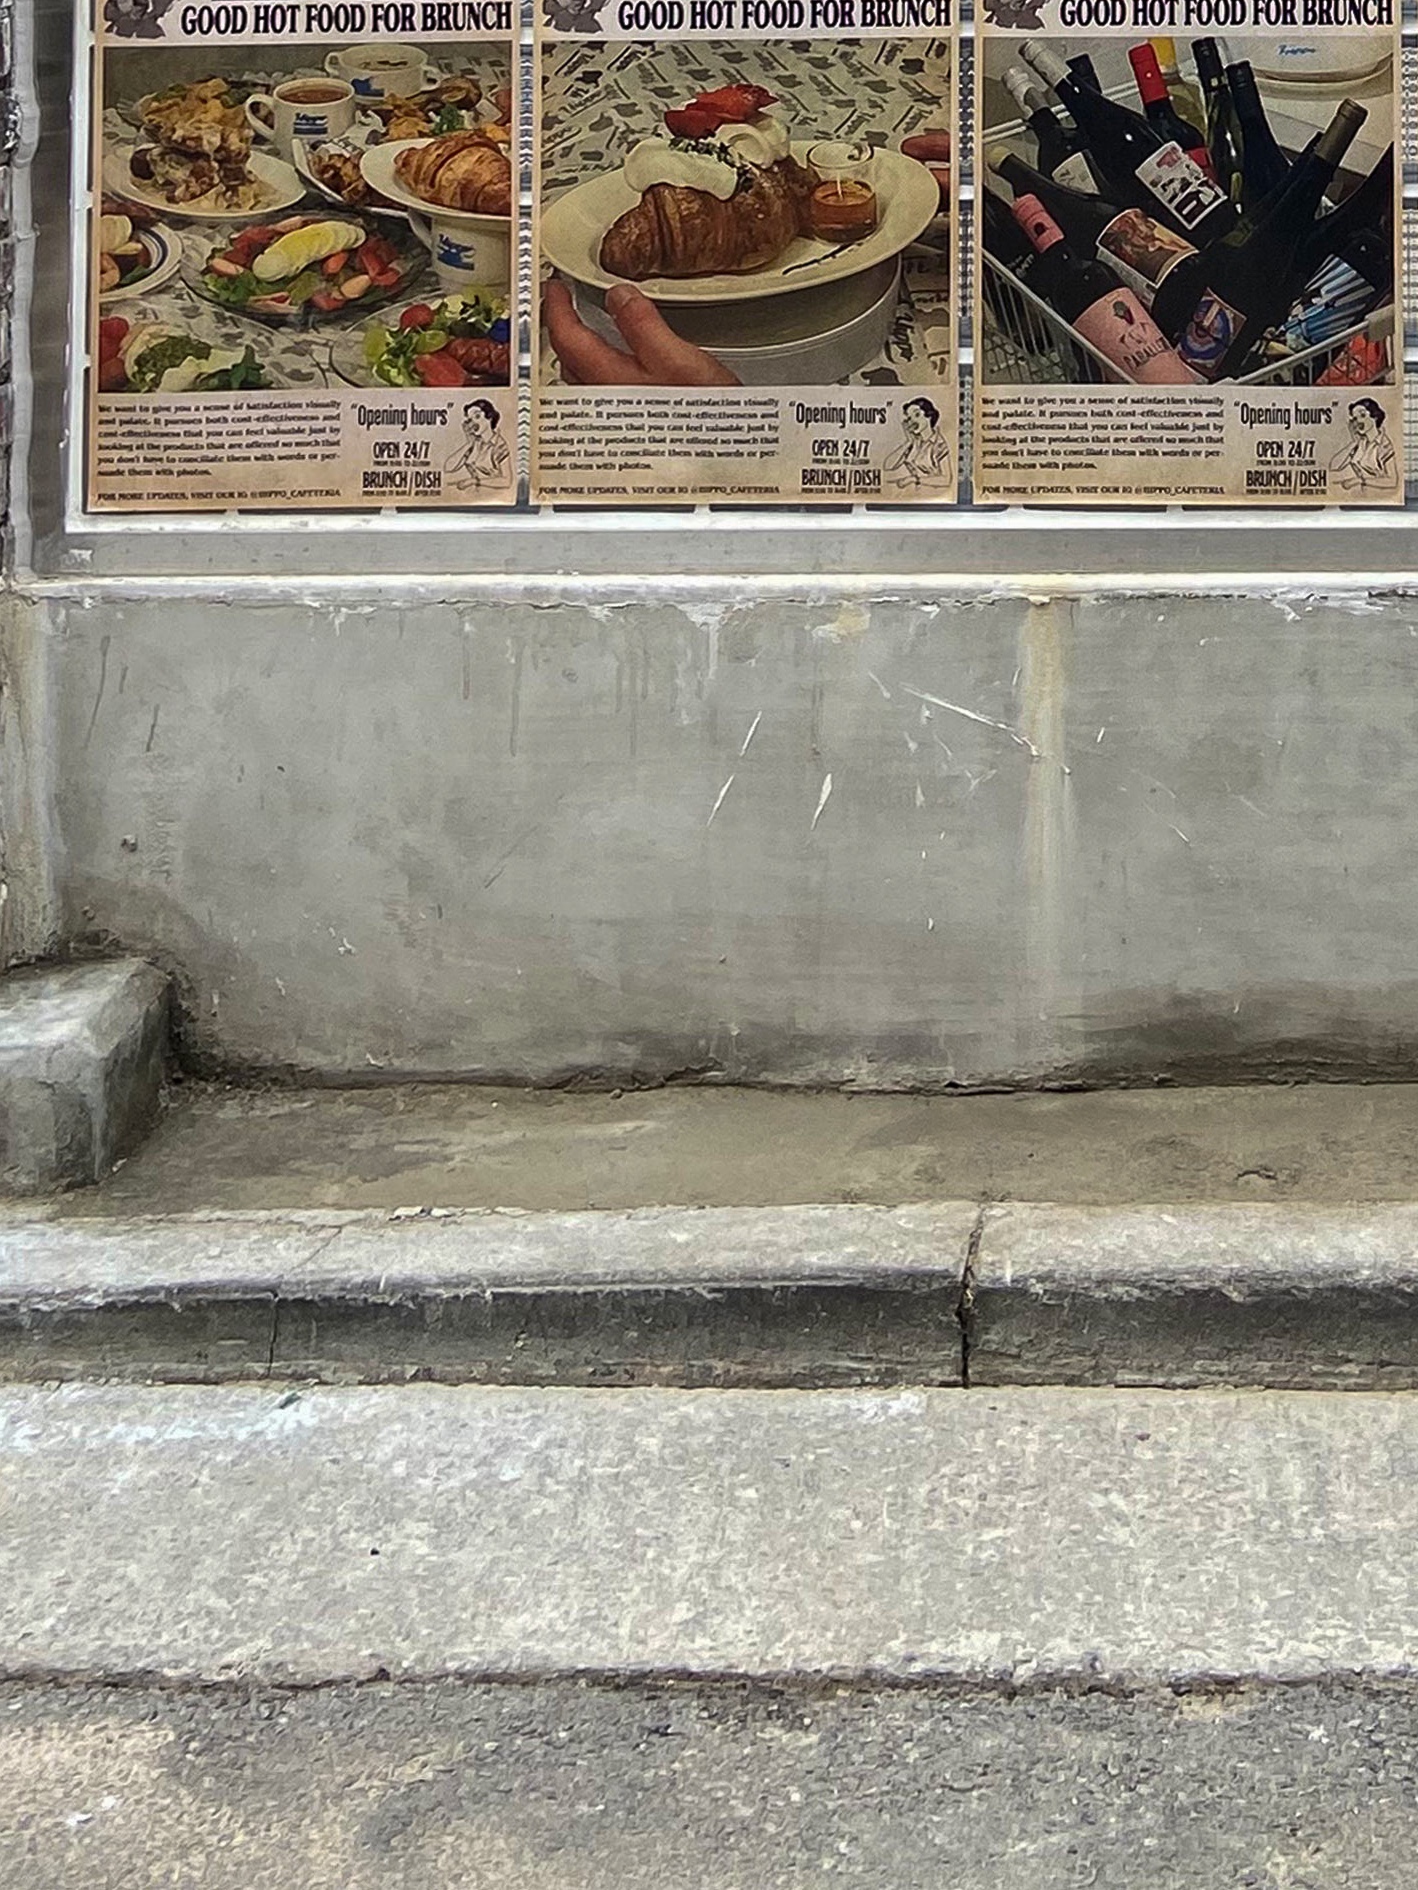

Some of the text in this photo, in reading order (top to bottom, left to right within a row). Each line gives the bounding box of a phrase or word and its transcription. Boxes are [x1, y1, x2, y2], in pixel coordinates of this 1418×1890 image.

[181, 0, 512, 35] GOOD HOT FOOD FOR BRUNCH
[618, 0, 684, 30] GOOD
[689, 0, 737, 29] HOT
[741, 0, 804, 29] FOOD
[373, 442, 430, 460] OPEN 24/7
[812, 440, 869, 458] OPEN 24/7
[1257, 441, 1316, 459] OPEN 24/7
